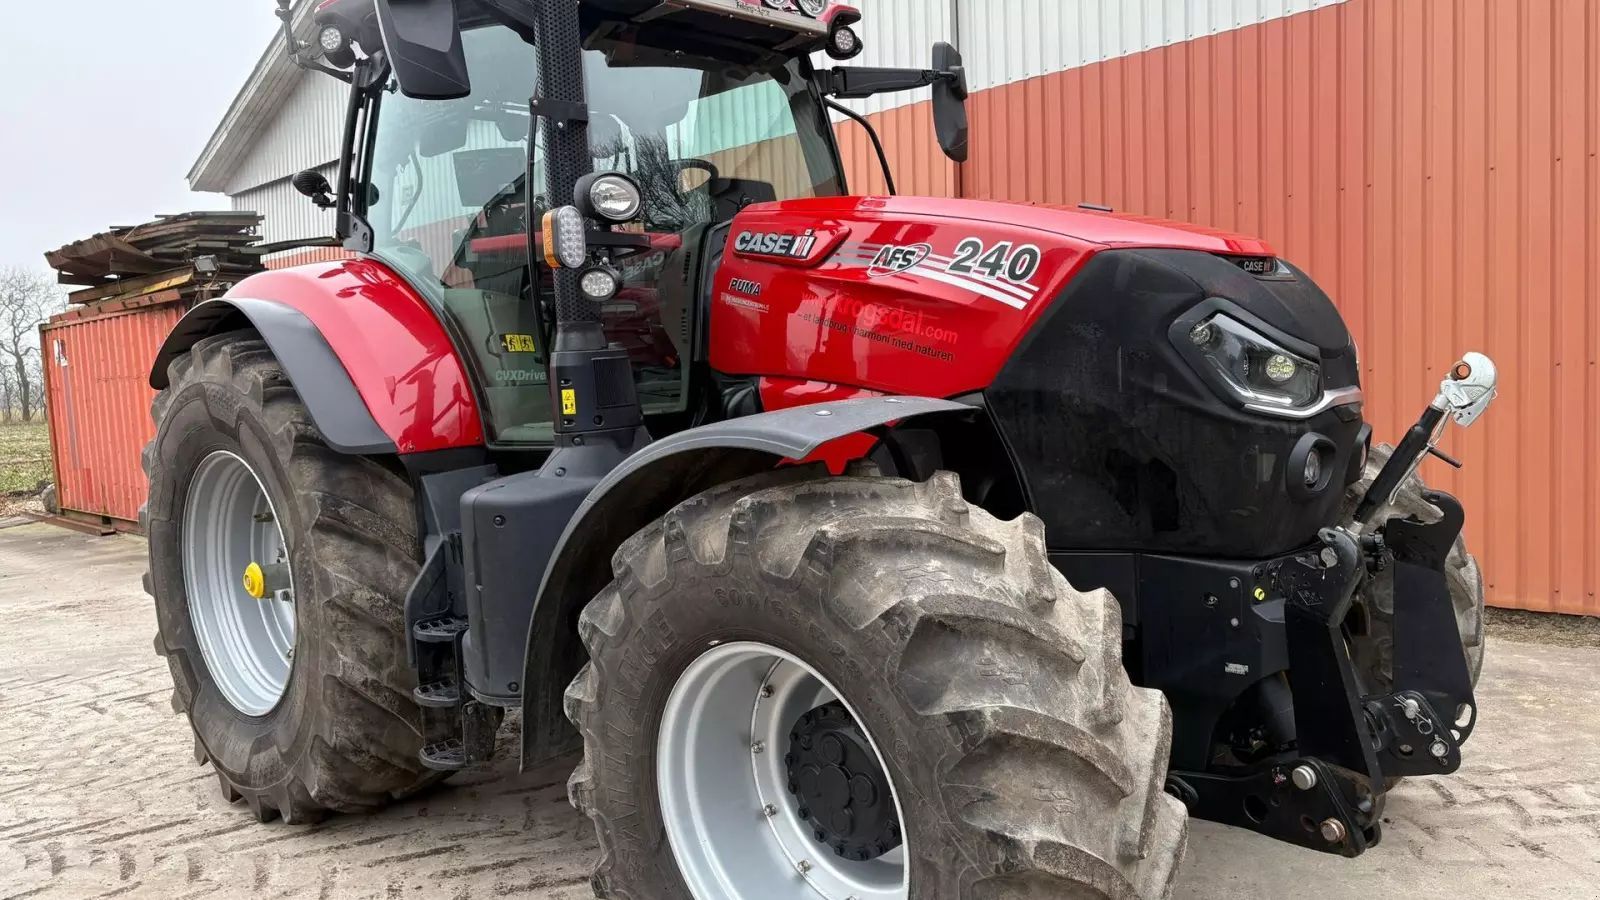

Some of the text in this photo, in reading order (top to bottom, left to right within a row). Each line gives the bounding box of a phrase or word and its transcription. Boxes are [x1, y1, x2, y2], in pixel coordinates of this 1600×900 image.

[735, 231, 789, 253] CASE
[872, 247, 917, 269] AFS
[945, 237, 1041, 285] 240
[1243, 261, 1264, 272] CASE
[729, 277, 761, 296] PUMA
[891, 335, 913, 351] med
[914, 342, 954, 362] naturen
[495, 369, 547, 381] CVXDrive
